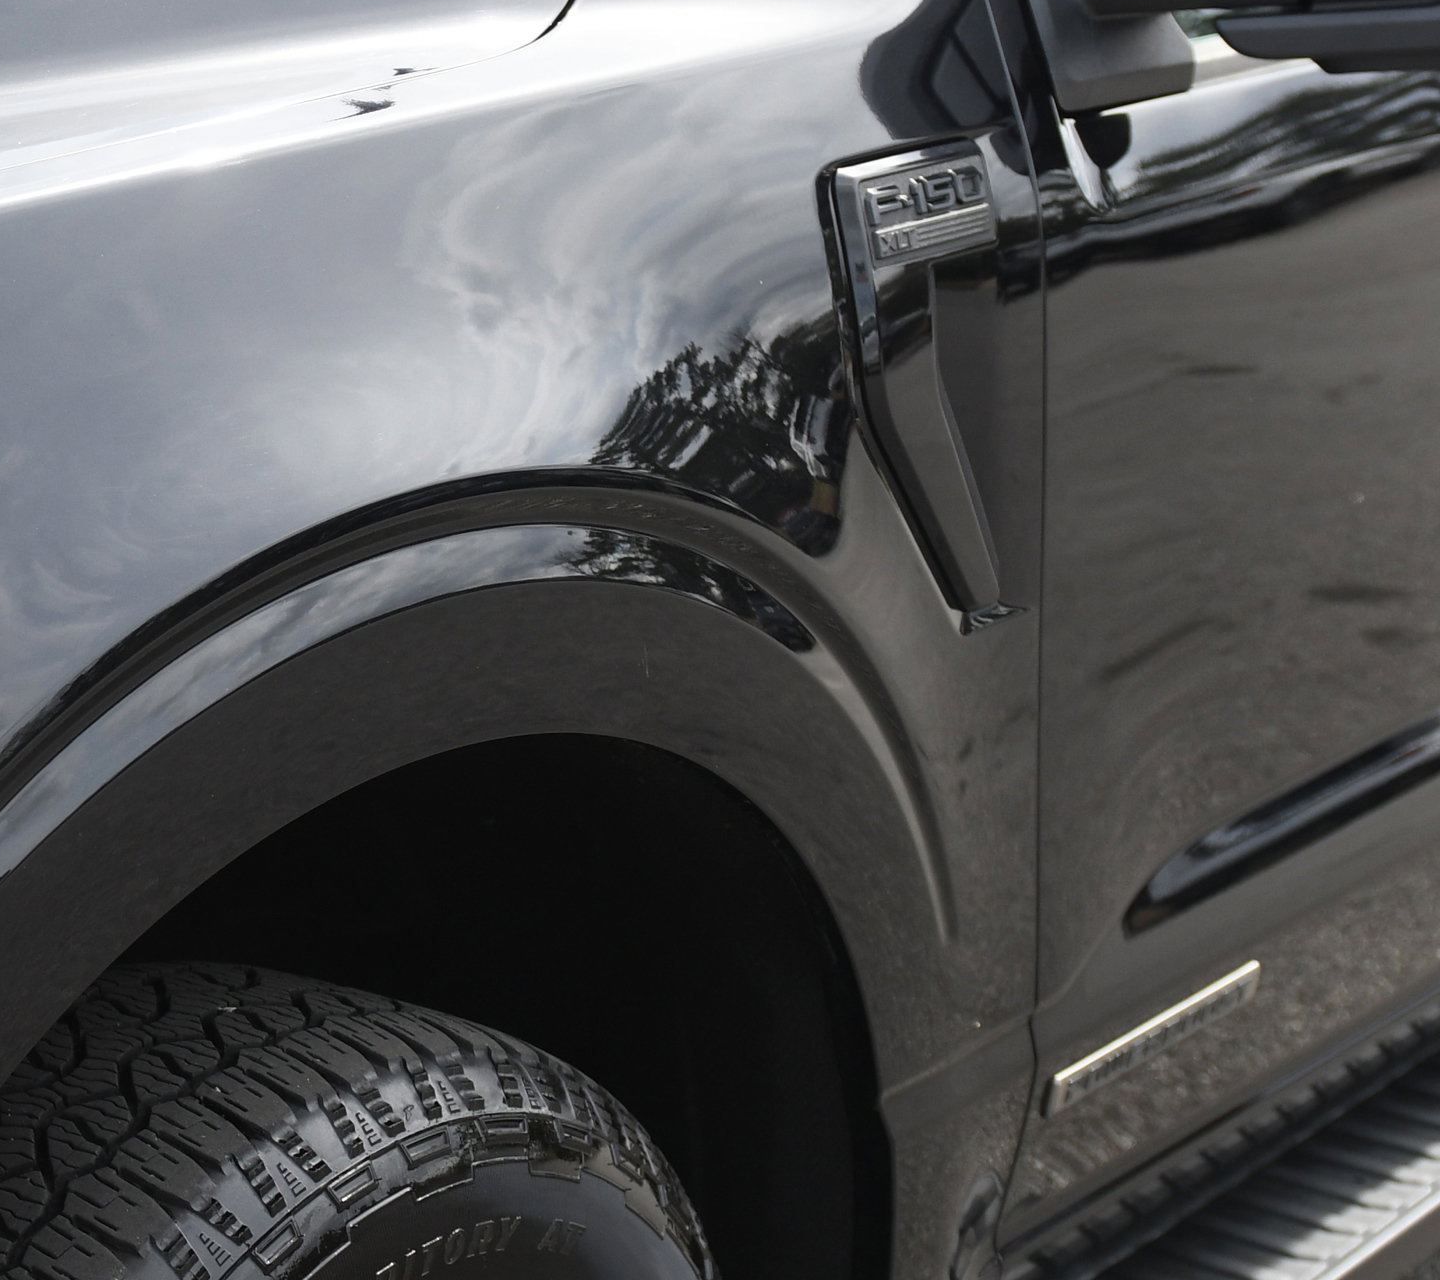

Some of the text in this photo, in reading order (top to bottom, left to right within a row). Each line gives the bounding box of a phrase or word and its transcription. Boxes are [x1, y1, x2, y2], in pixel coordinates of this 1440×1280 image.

[865, 166, 988, 226] F-150
[880, 228, 918, 253] XLT
[536, 1218, 587, 1256] AT
